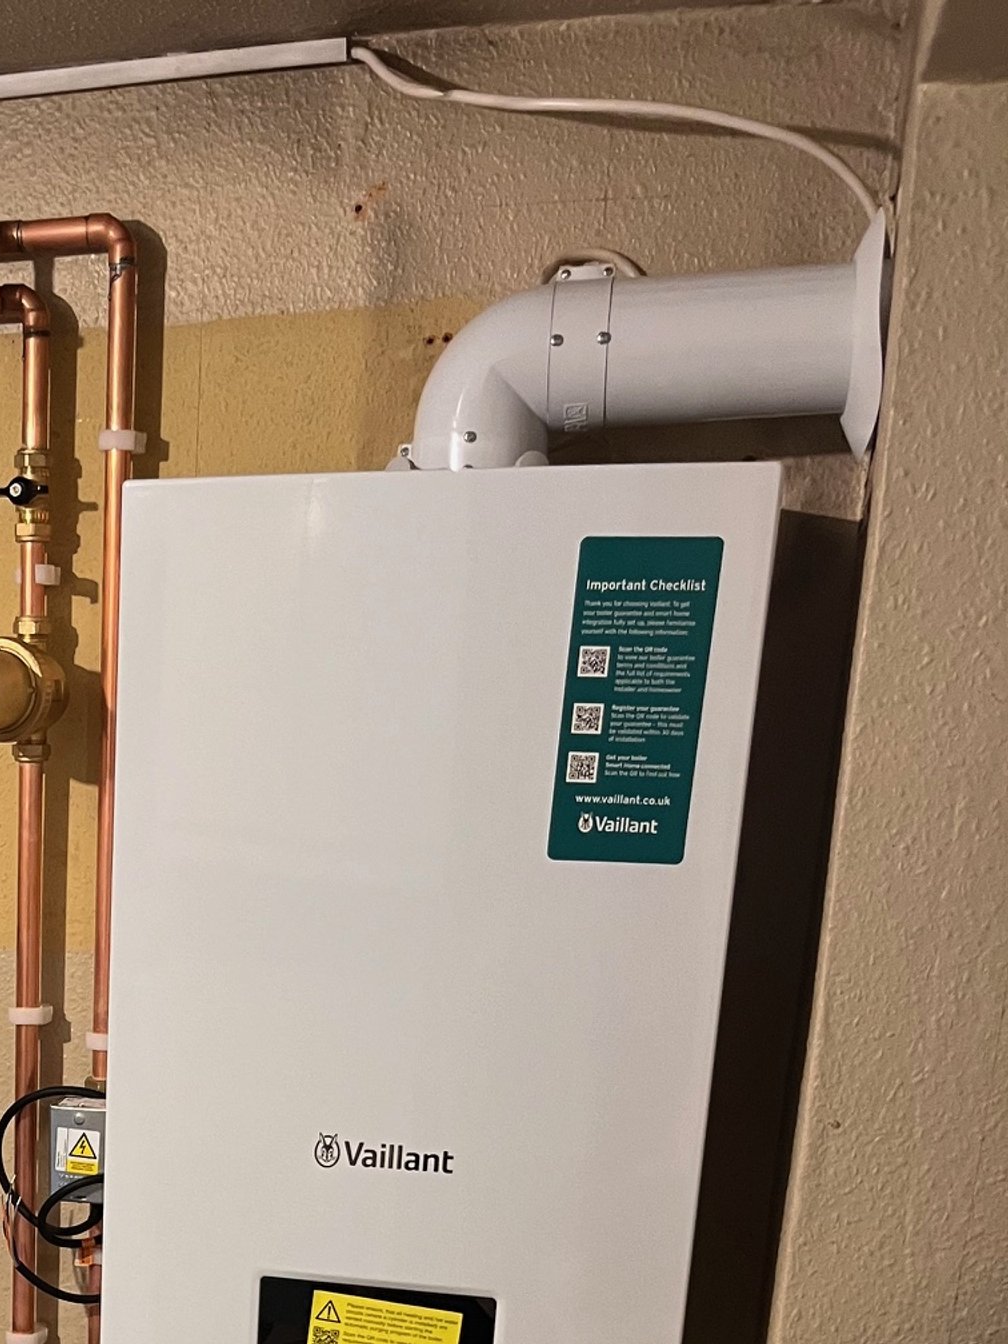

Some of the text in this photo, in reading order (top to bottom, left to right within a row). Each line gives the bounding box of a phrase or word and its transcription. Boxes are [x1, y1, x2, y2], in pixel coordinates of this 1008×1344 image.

[586, 579, 706, 593] Important Checklist
[575, 794, 670, 806] www.vaillant.co.uk
[595, 816, 658, 834] Vaillant
[344, 1140, 455, 1174] Vaillant
